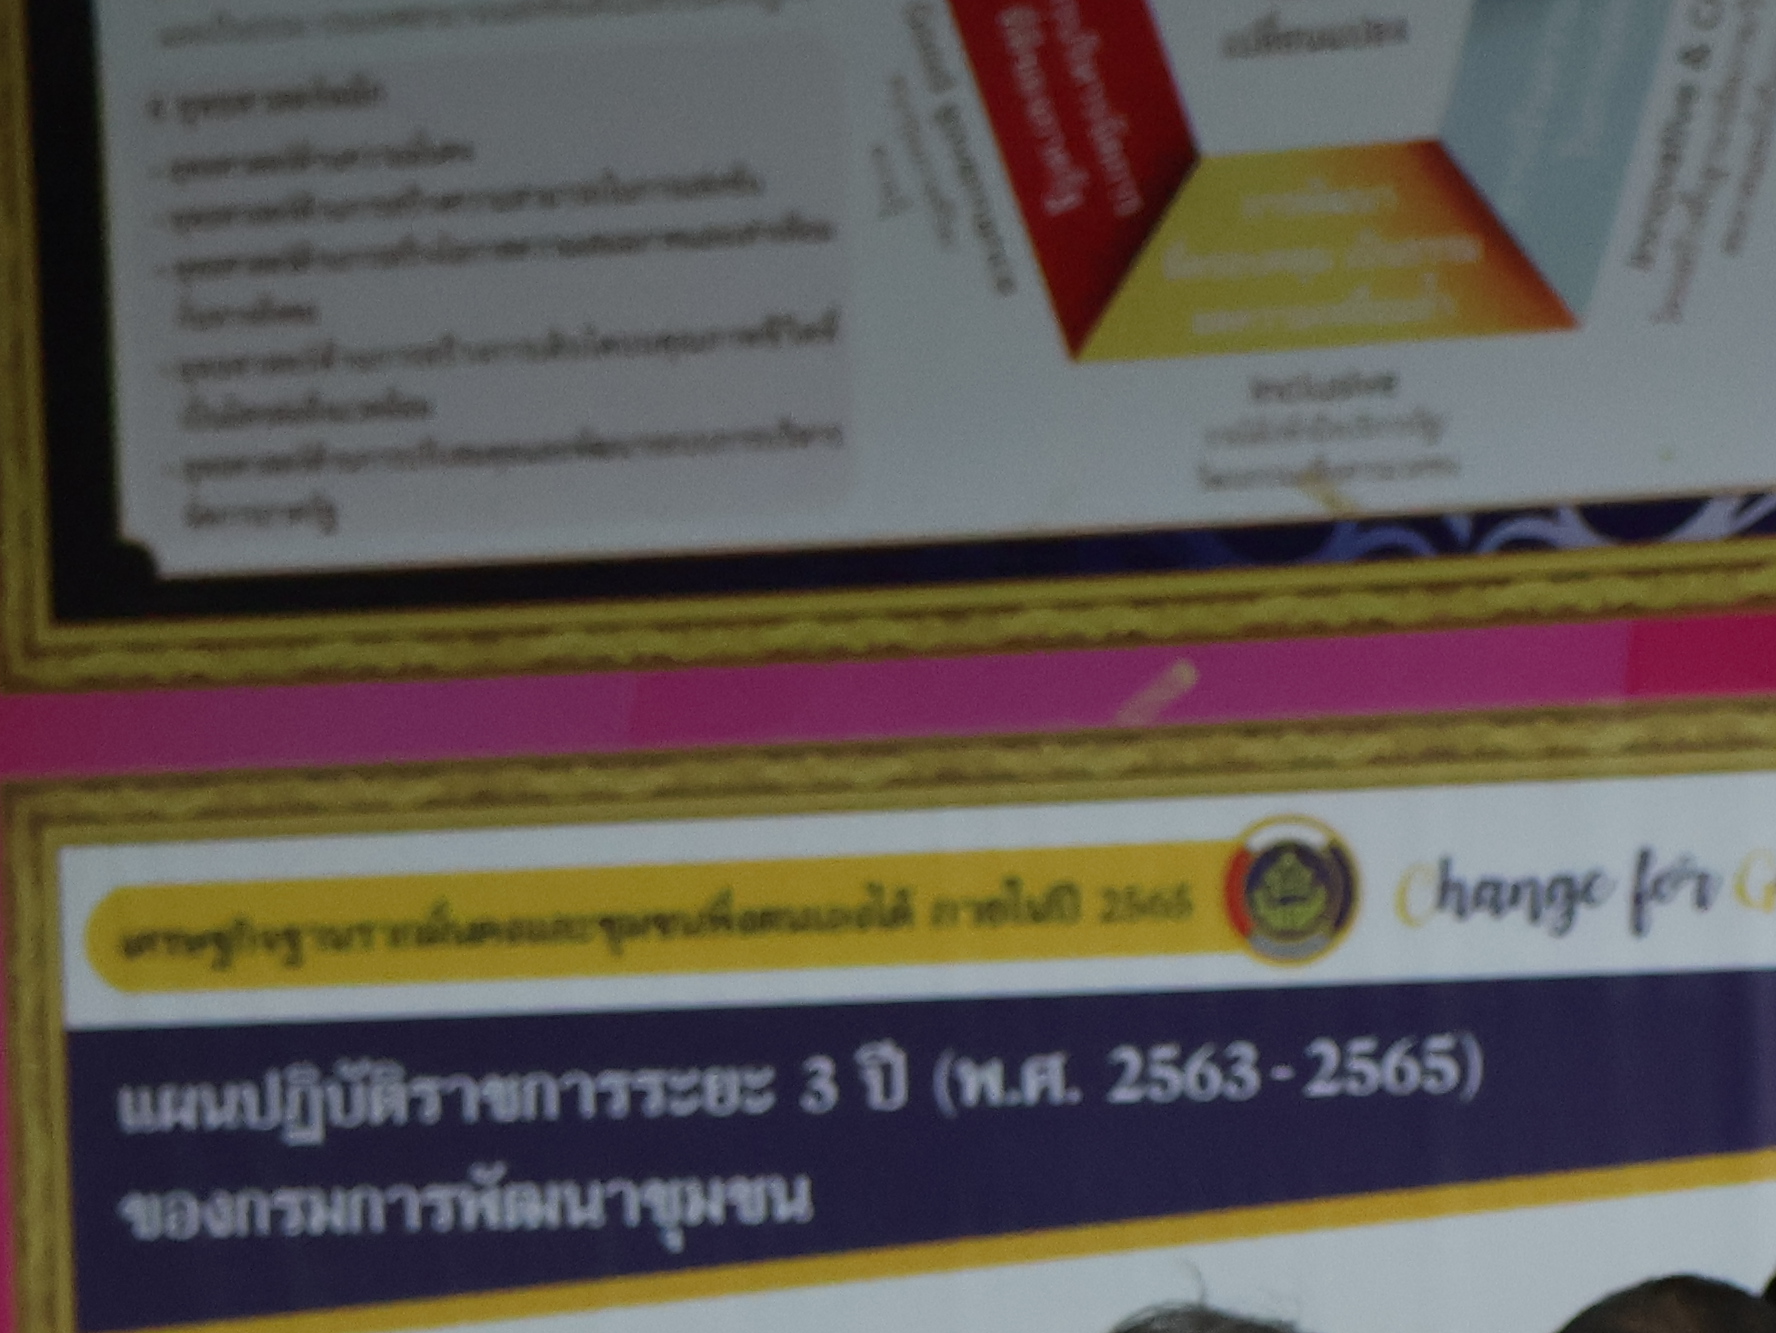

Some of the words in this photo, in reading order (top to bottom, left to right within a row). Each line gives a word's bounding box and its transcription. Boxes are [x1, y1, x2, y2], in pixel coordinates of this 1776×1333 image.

[1394, 854, 1612, 937] Change
[1628, 845, 1722, 938] for
[800, 1054, 840, 1113] 3
[854, 1038, 910, 1112] ปี
[932, 1048, 1082, 1117] (พ.ศ.
[119, 1163, 816, 1253] ของกรมการพัฒนาชุมชน
